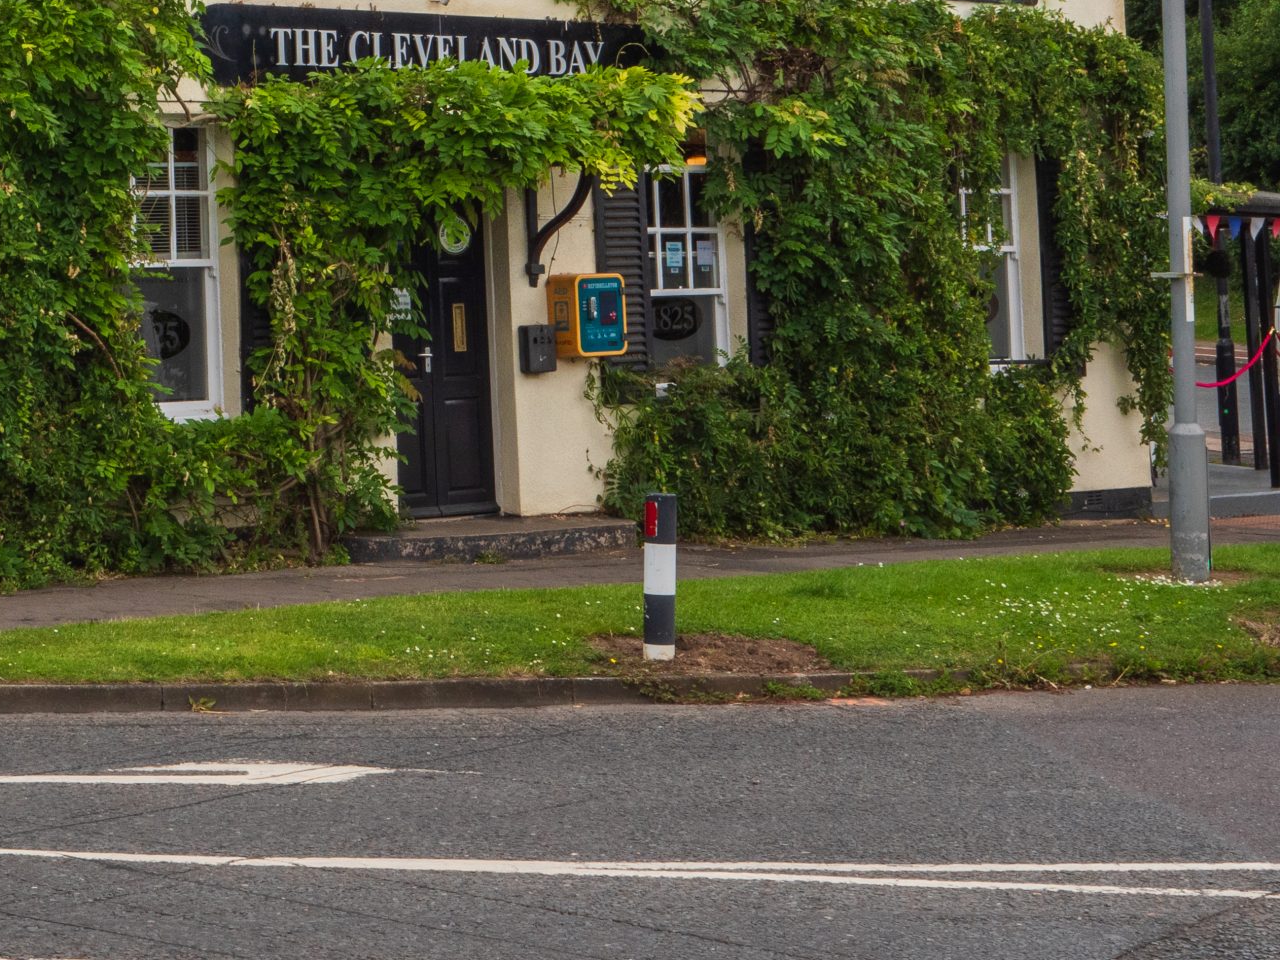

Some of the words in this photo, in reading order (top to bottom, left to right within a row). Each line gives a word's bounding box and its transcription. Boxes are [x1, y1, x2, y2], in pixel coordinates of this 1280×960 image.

[270, 27, 339, 67] THE
[348, 30, 540, 74] CLEVELAND
[547, 39, 604, 76] BAY
[651, 305, 694, 330] 1825
